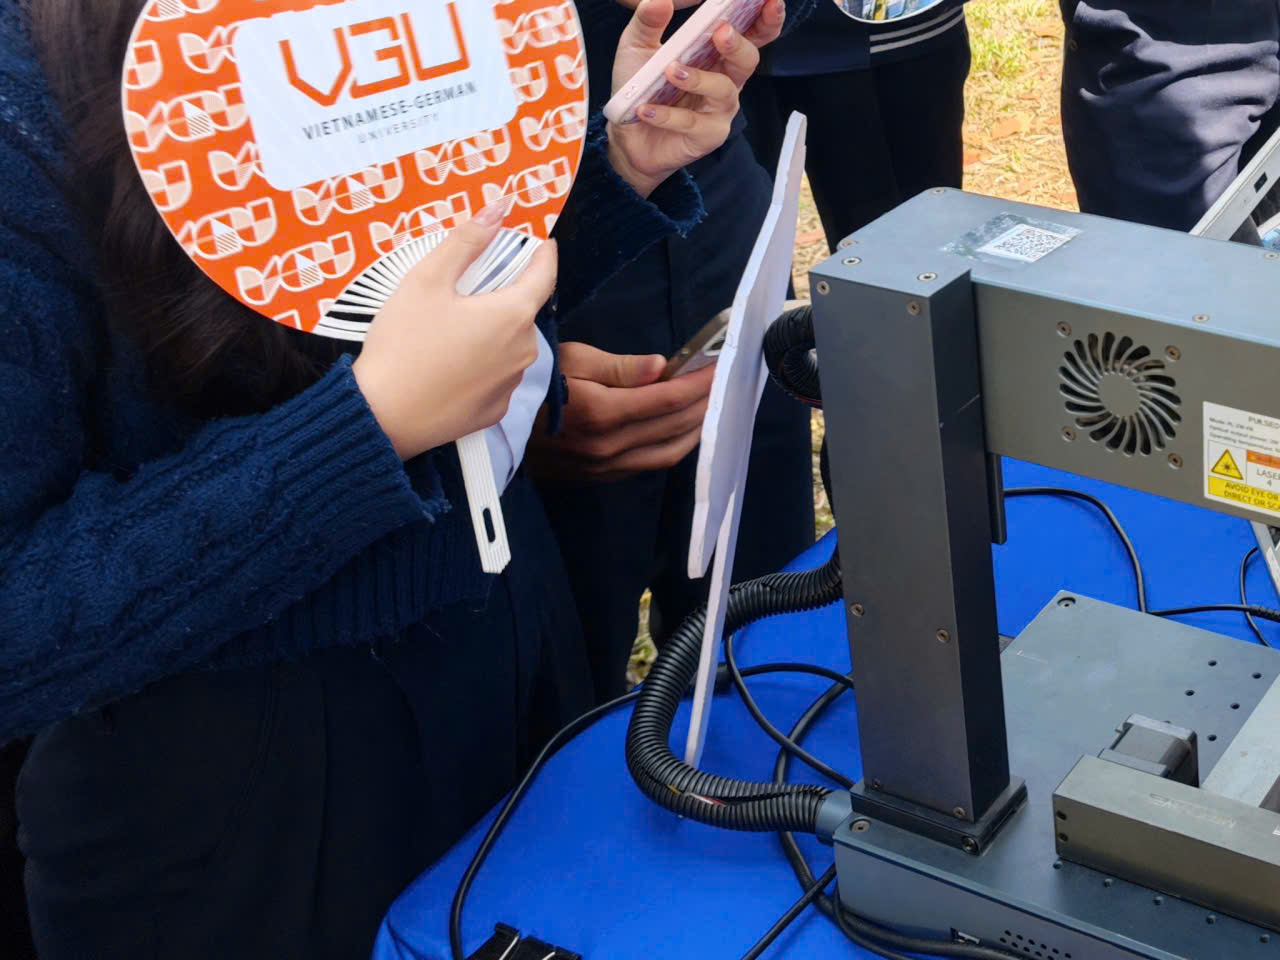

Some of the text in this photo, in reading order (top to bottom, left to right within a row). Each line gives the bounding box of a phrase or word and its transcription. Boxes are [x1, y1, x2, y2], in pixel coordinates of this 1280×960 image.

[279, 1, 471, 108] VGU
[301, 80, 478, 141] VIETNAMESE-GERMAN
[358, 112, 439, 144] UNIVERSITY
[1248, 415, 1280, 430] PULSED
[1225, 481, 1249, 495] AVOID
[1250, 487, 1267, 498] EYE
[1267, 491, 1279, 501] OR
[1267, 479, 1272, 487] 4
[1224, 490, 1252, 505] DIRECT
[1254, 498, 1266, 508] OR
